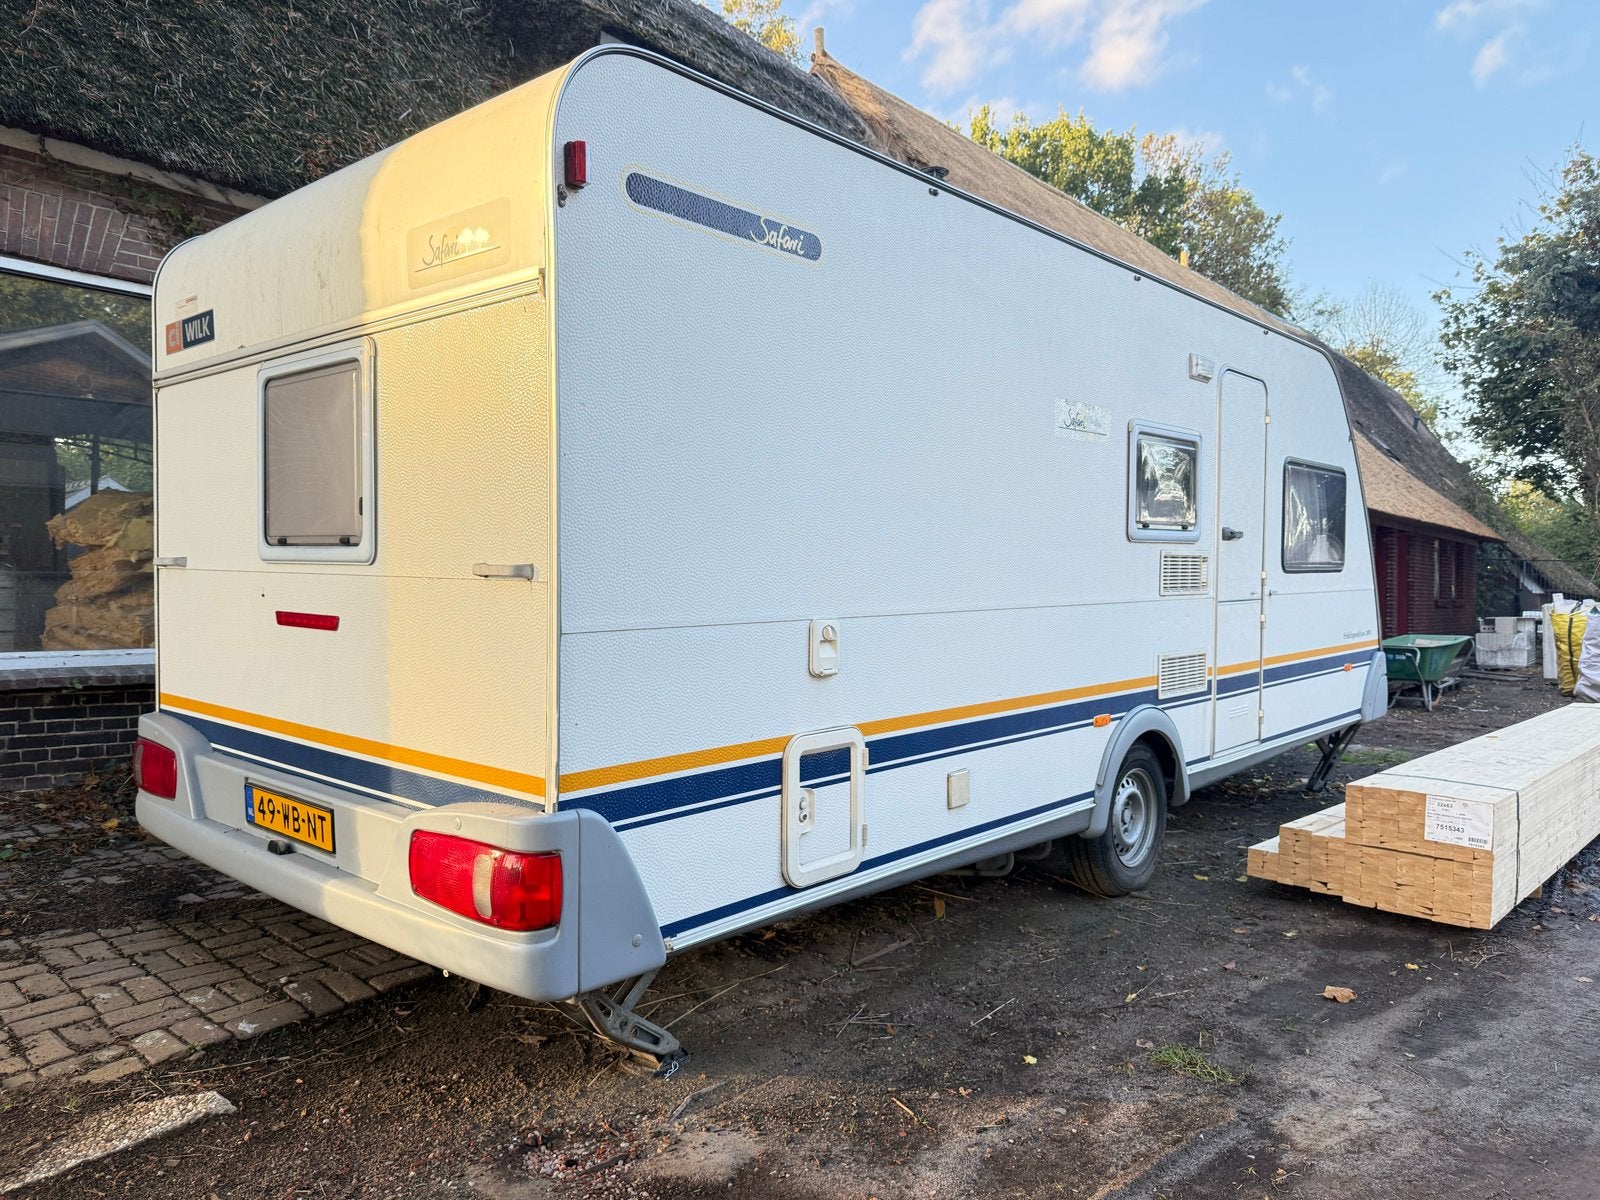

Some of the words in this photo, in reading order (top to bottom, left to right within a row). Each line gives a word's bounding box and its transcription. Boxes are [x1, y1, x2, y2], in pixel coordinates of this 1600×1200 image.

[421, 233, 461, 268] Safari
[749, 216, 805, 255] Safari
[184, 315, 211, 343] WILK
[257, 795, 327, 844] 49-WB-NT
[1435, 823, 1466, 834] 7515343
